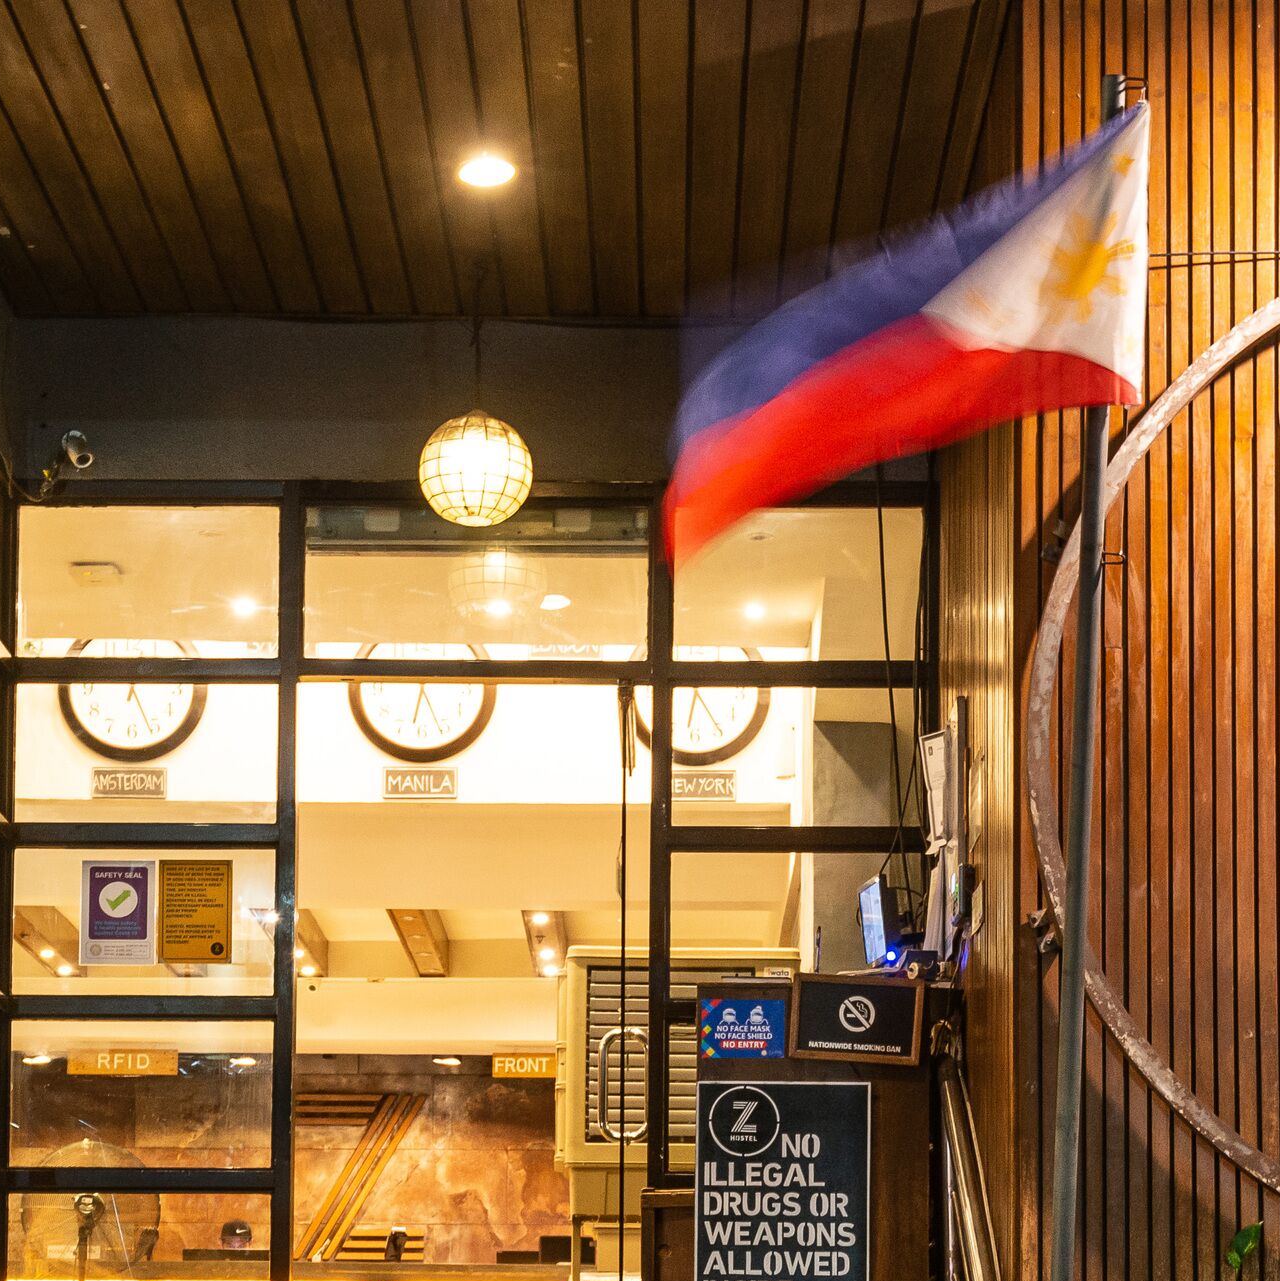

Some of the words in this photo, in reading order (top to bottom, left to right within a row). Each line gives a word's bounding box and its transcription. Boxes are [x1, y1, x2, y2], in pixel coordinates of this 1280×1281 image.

[93, 774, 164, 791] AMSTERDAM
[387, 776, 454, 793] MANILA
[672, 777, 697, 794] EW
[698, 777, 735, 794] YORK
[747, 1032, 773, 1040] SHIELD
[808, 1041, 852, 1050] NATIONWIDE
[853, 1043, 885, 1052] SMOKING
[886, 1045, 901, 1053] BAN
[97, 1053, 150, 1069] RFID
[494, 1057, 550, 1073] FRONT
[730, 1101, 758, 1133] Z
[781, 1133, 821, 1158] NO
[703, 1162, 826, 1187] ILLEGAL
[703, 1191, 801, 1217] DRUGS
[809, 1192, 849, 1218] OR
[704, 1221, 856, 1247] WEAPONS
[703, 1250, 851, 1276] ALLOWED
